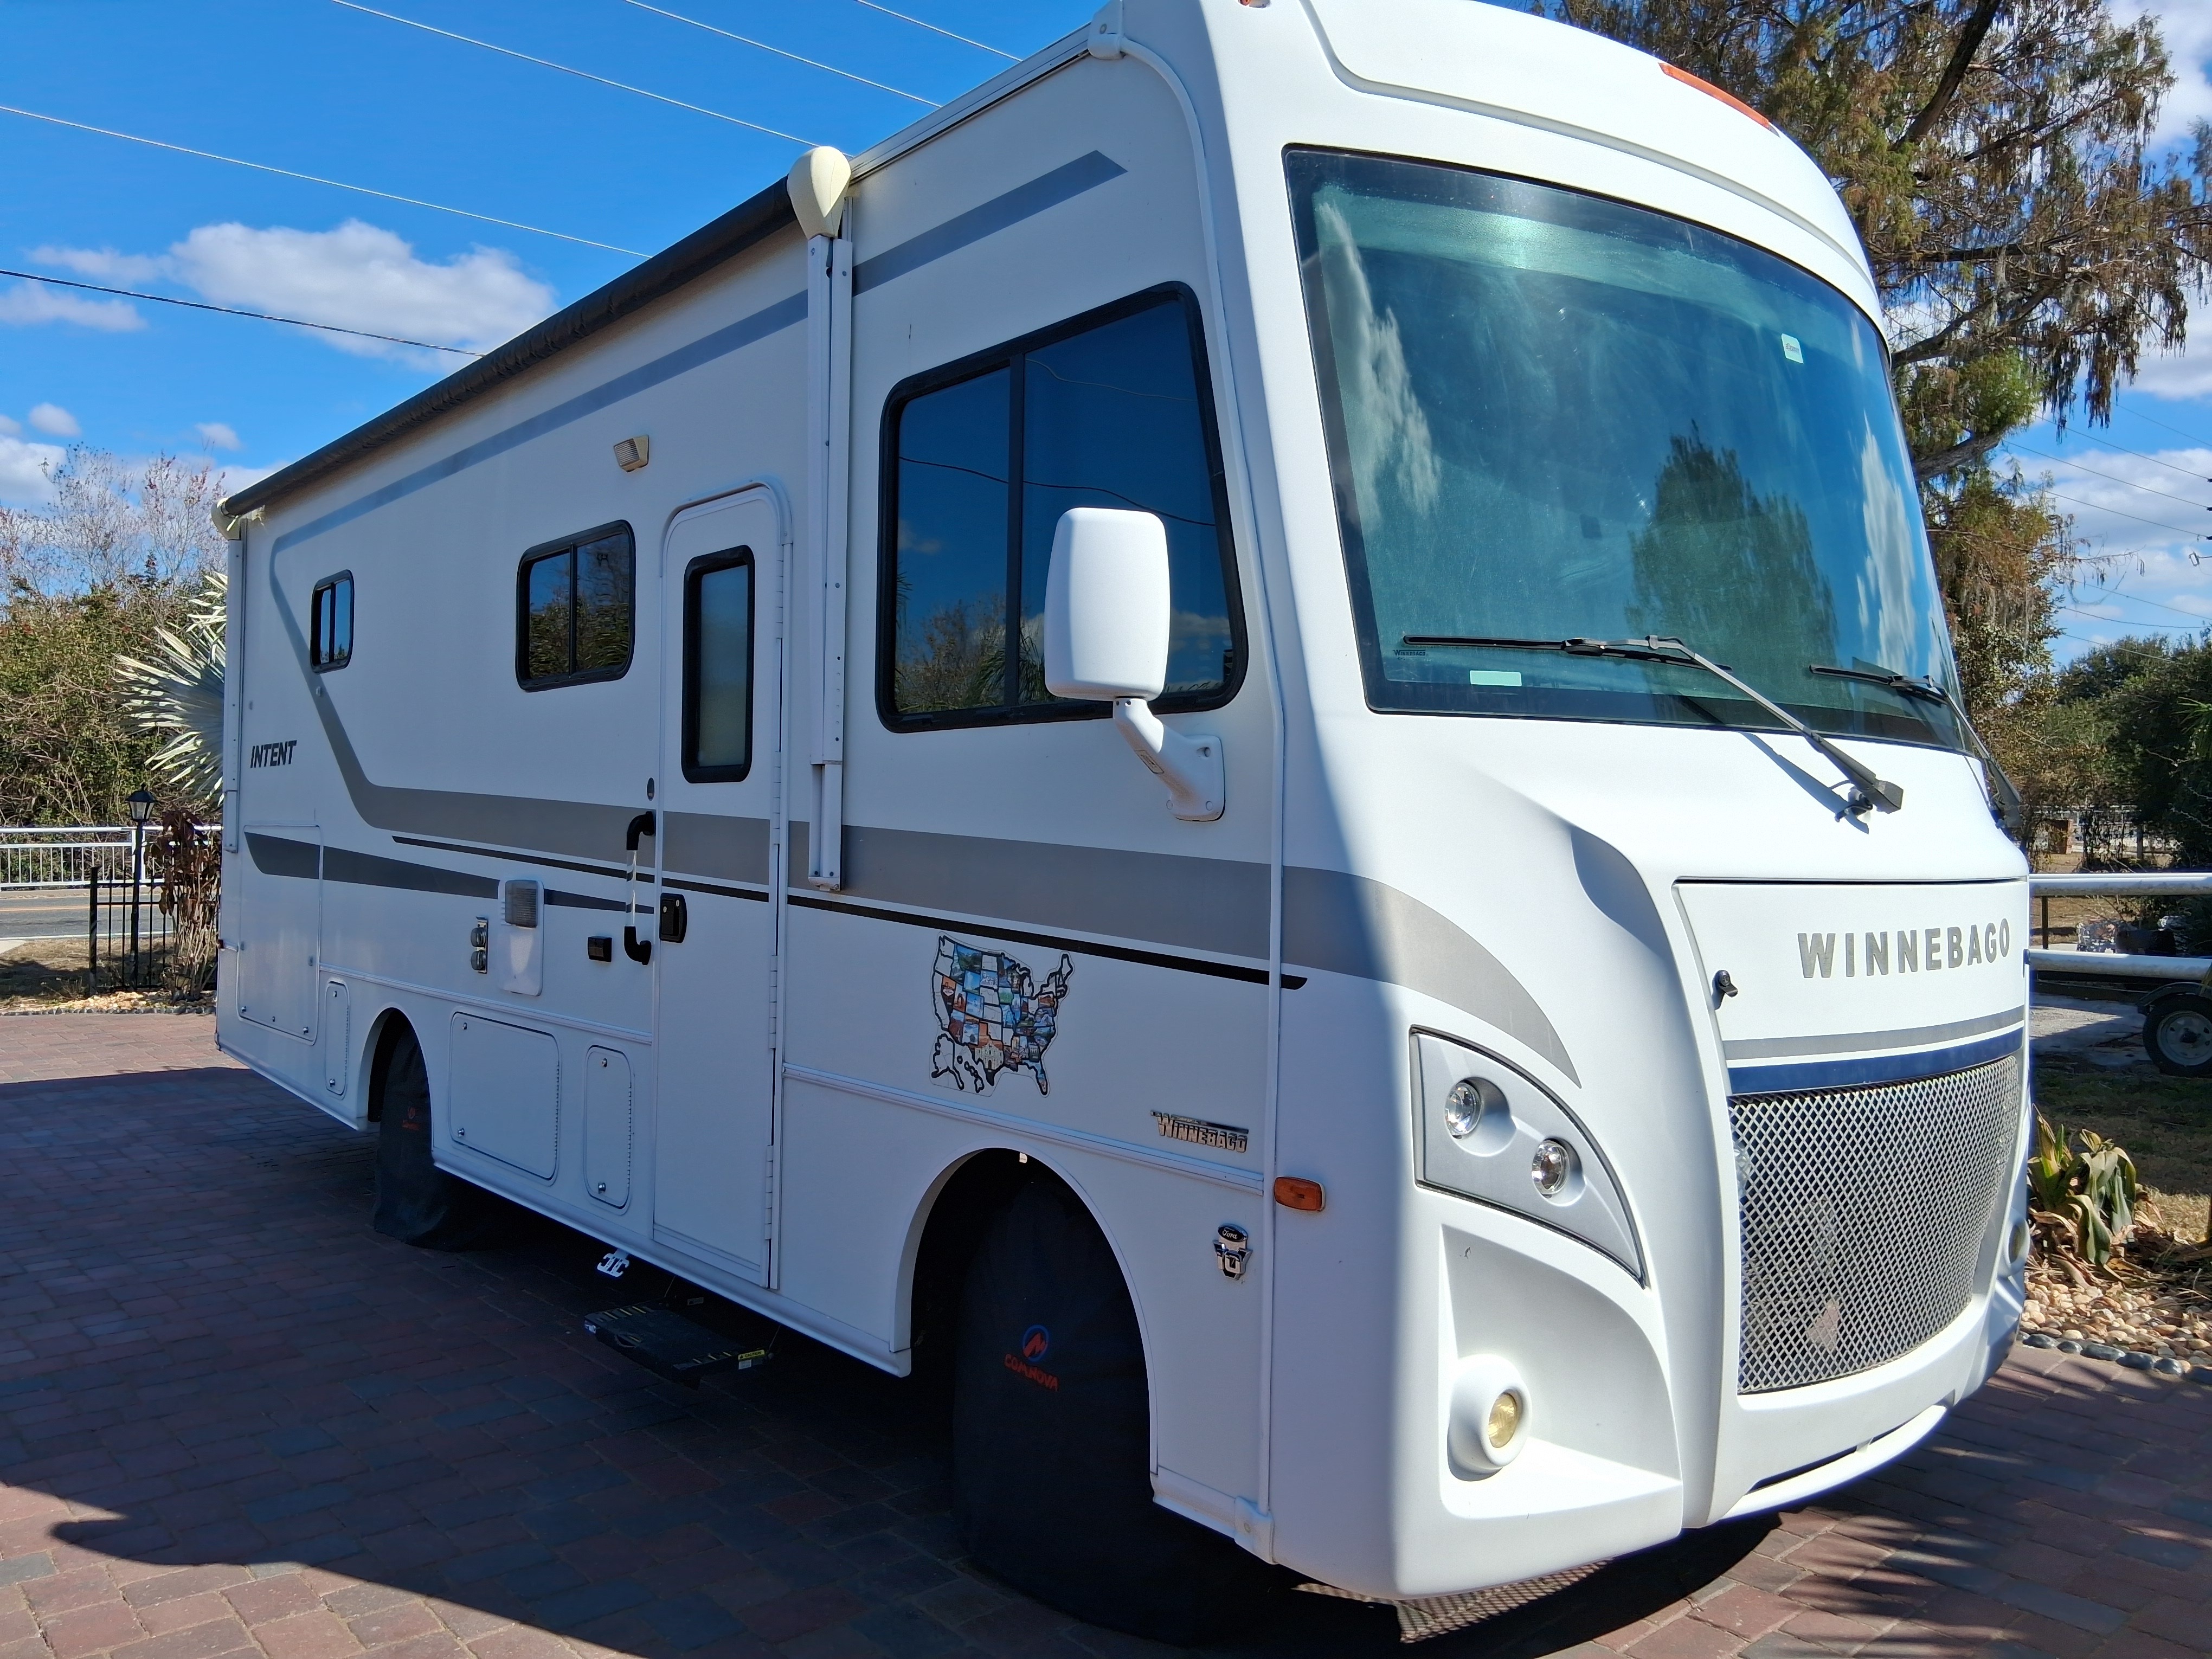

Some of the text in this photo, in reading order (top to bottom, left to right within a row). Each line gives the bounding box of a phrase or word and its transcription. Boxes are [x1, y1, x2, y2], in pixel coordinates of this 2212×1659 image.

[250, 740, 297, 768] INTENT
[1797, 918, 2010, 978] WINNEBAGO
[1150, 1110, 1249, 1153] WINNEBAGO
[1222, 1227, 1238, 1239] Ford
